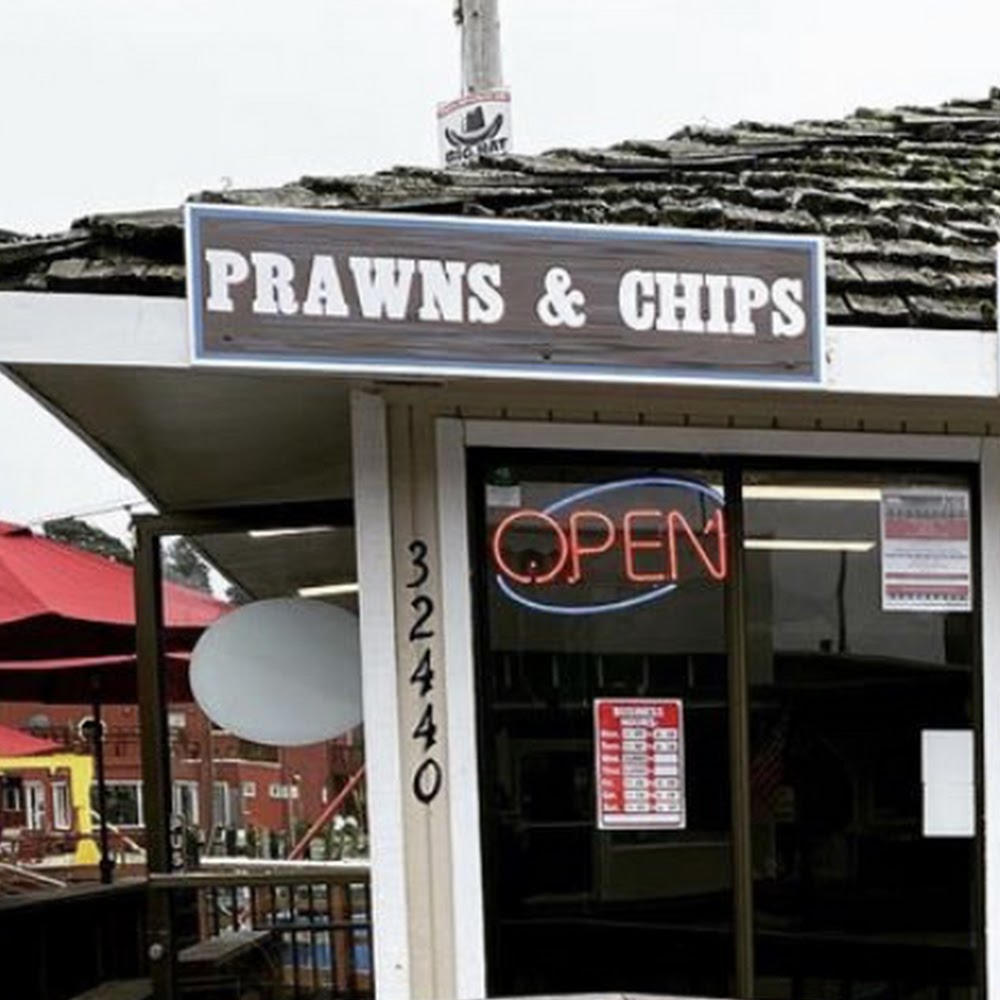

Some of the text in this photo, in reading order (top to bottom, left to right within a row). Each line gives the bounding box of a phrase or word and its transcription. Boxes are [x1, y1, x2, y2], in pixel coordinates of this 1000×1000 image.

[205, 248, 807, 337] PRAWNS & CHIPS
[492, 508, 728, 585] OPEN
[405, 538, 443, 806] 32440
